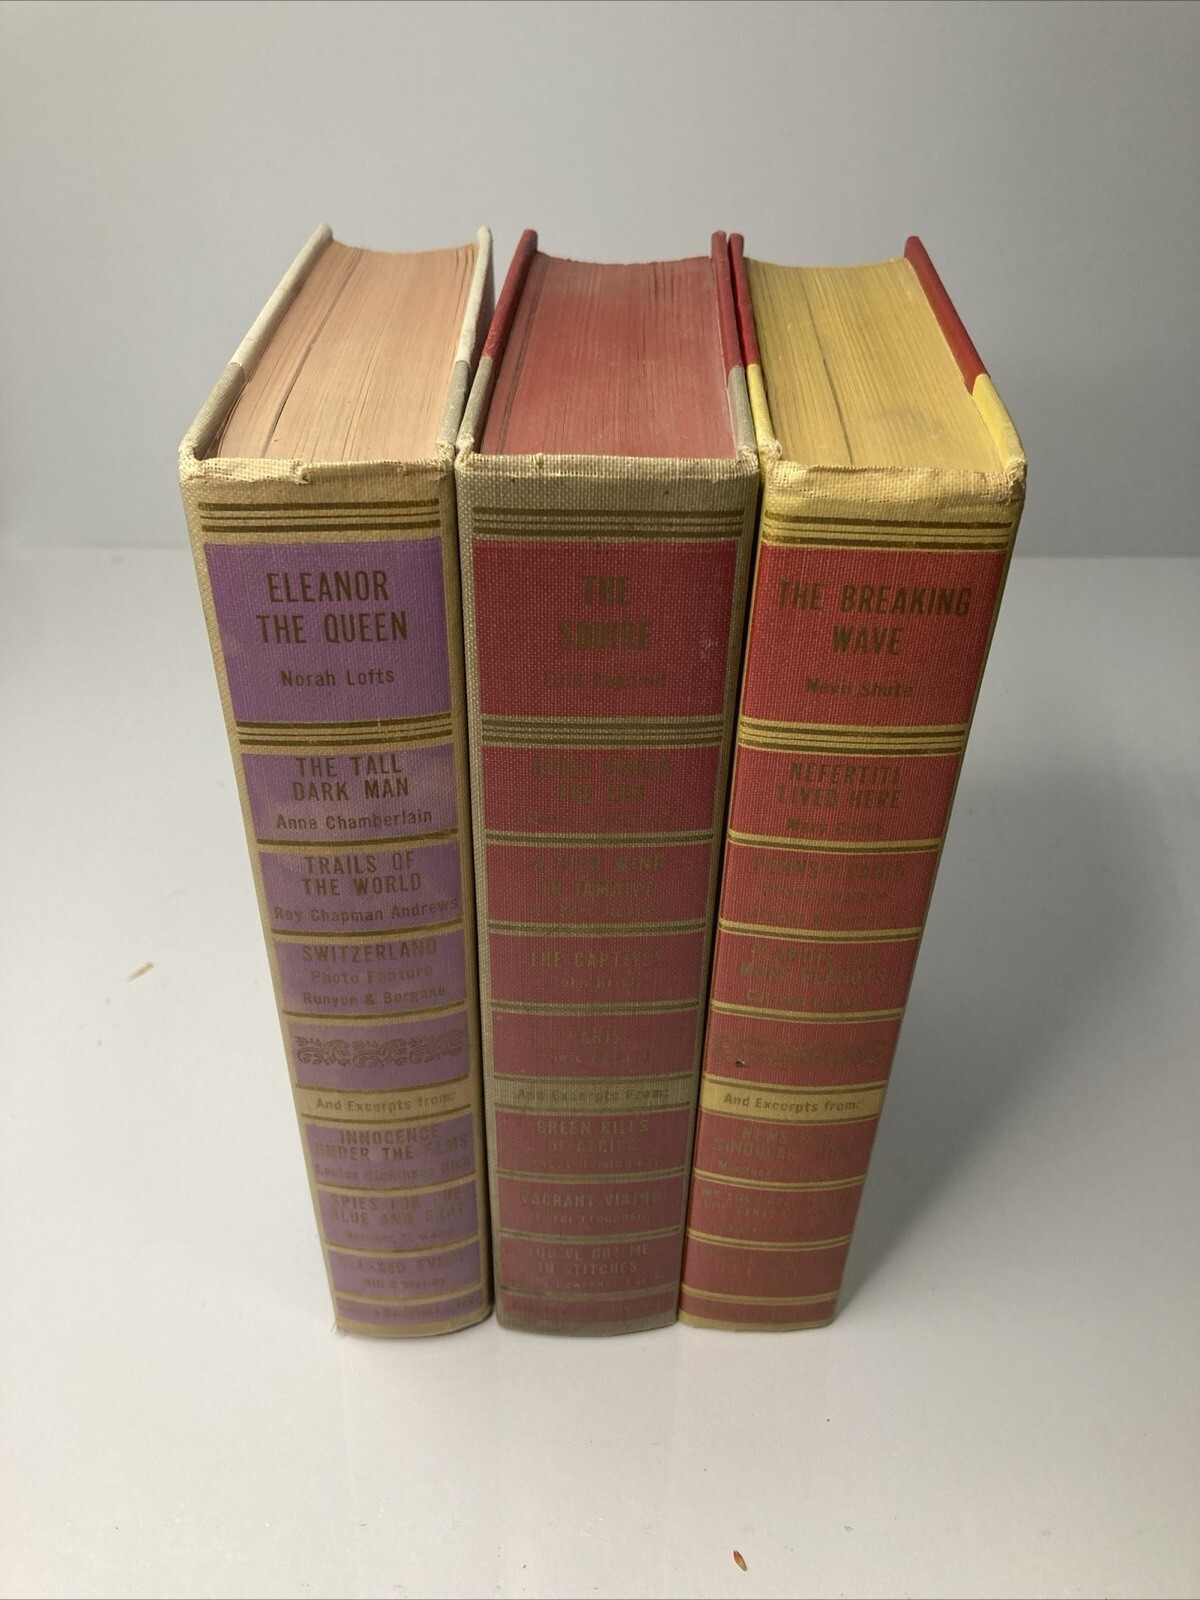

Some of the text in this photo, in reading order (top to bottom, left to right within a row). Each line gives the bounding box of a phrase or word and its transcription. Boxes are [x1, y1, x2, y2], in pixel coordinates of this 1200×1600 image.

[266, 570, 390, 603] ELEANOR
[582, 574, 631, 607] THE
[777, 579, 972, 617] THE BREAKING
[256, 611, 408, 644] THE QUEEN
[558, 619, 651, 650] SQUIRE
[831, 626, 902, 655] WAVE
[280, 669, 395, 687] Norah Lofts
[296, 754, 403, 778] THE TALL
[788, 760, 900, 785] NEFERTITI
[292, 778, 409, 801] DARK MAN
[777, 784, 902, 809] LIVED HERE
[276, 810, 433, 830] Anne Chamberlain
[304, 850, 415, 875] TRAILS OF
[302, 873, 422, 896] THE WORLD
[275, 899, 457, 926] Roy Chapman Andrews
[303, 938, 437, 963] SWITZERLAND
[310, 966, 433, 985] Photo Feature
[365, 993, 376, 1005] &
[316, 1098, 341, 1111] And
[347, 1099, 412, 1115] Excerpts
[723, 1093, 749, 1107] And
[755, 1096, 819, 1114] Excerpts
[340, 1124, 440, 1146] INNOCENCE
[381, 1146, 414, 1161] THE
